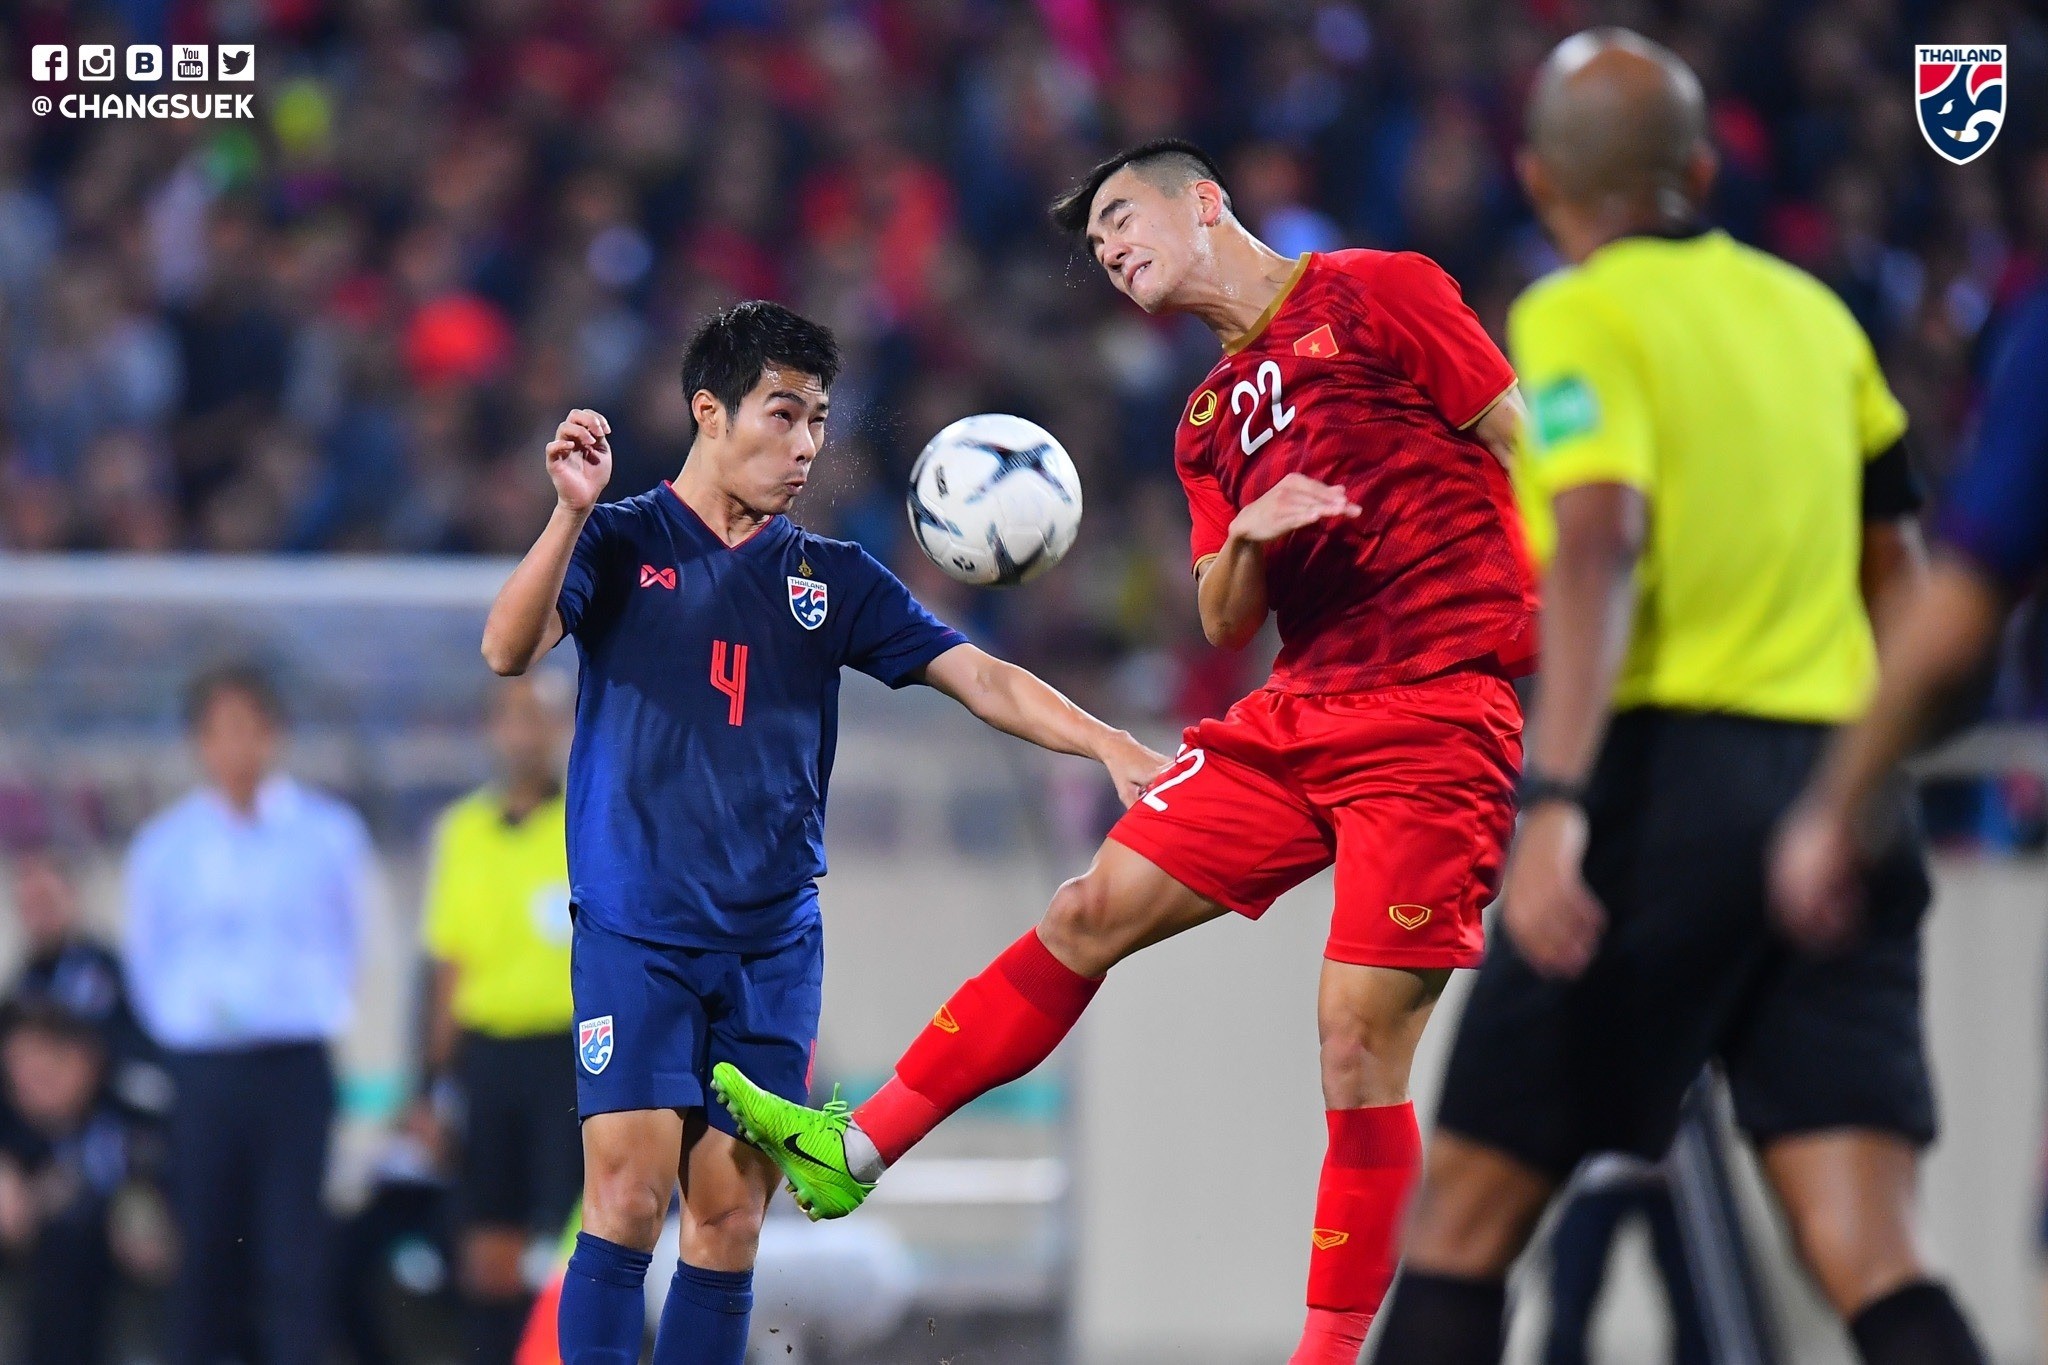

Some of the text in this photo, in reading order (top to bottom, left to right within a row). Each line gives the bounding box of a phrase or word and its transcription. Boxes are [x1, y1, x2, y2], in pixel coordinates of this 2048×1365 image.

[1231, 360, 1295, 456] 22
[790, 578, 825, 591] THAILAND
[710, 639, 748, 727] 4
[1142, 743, 1205, 812] 2
[581, 1018, 610, 1031] THAILAND
